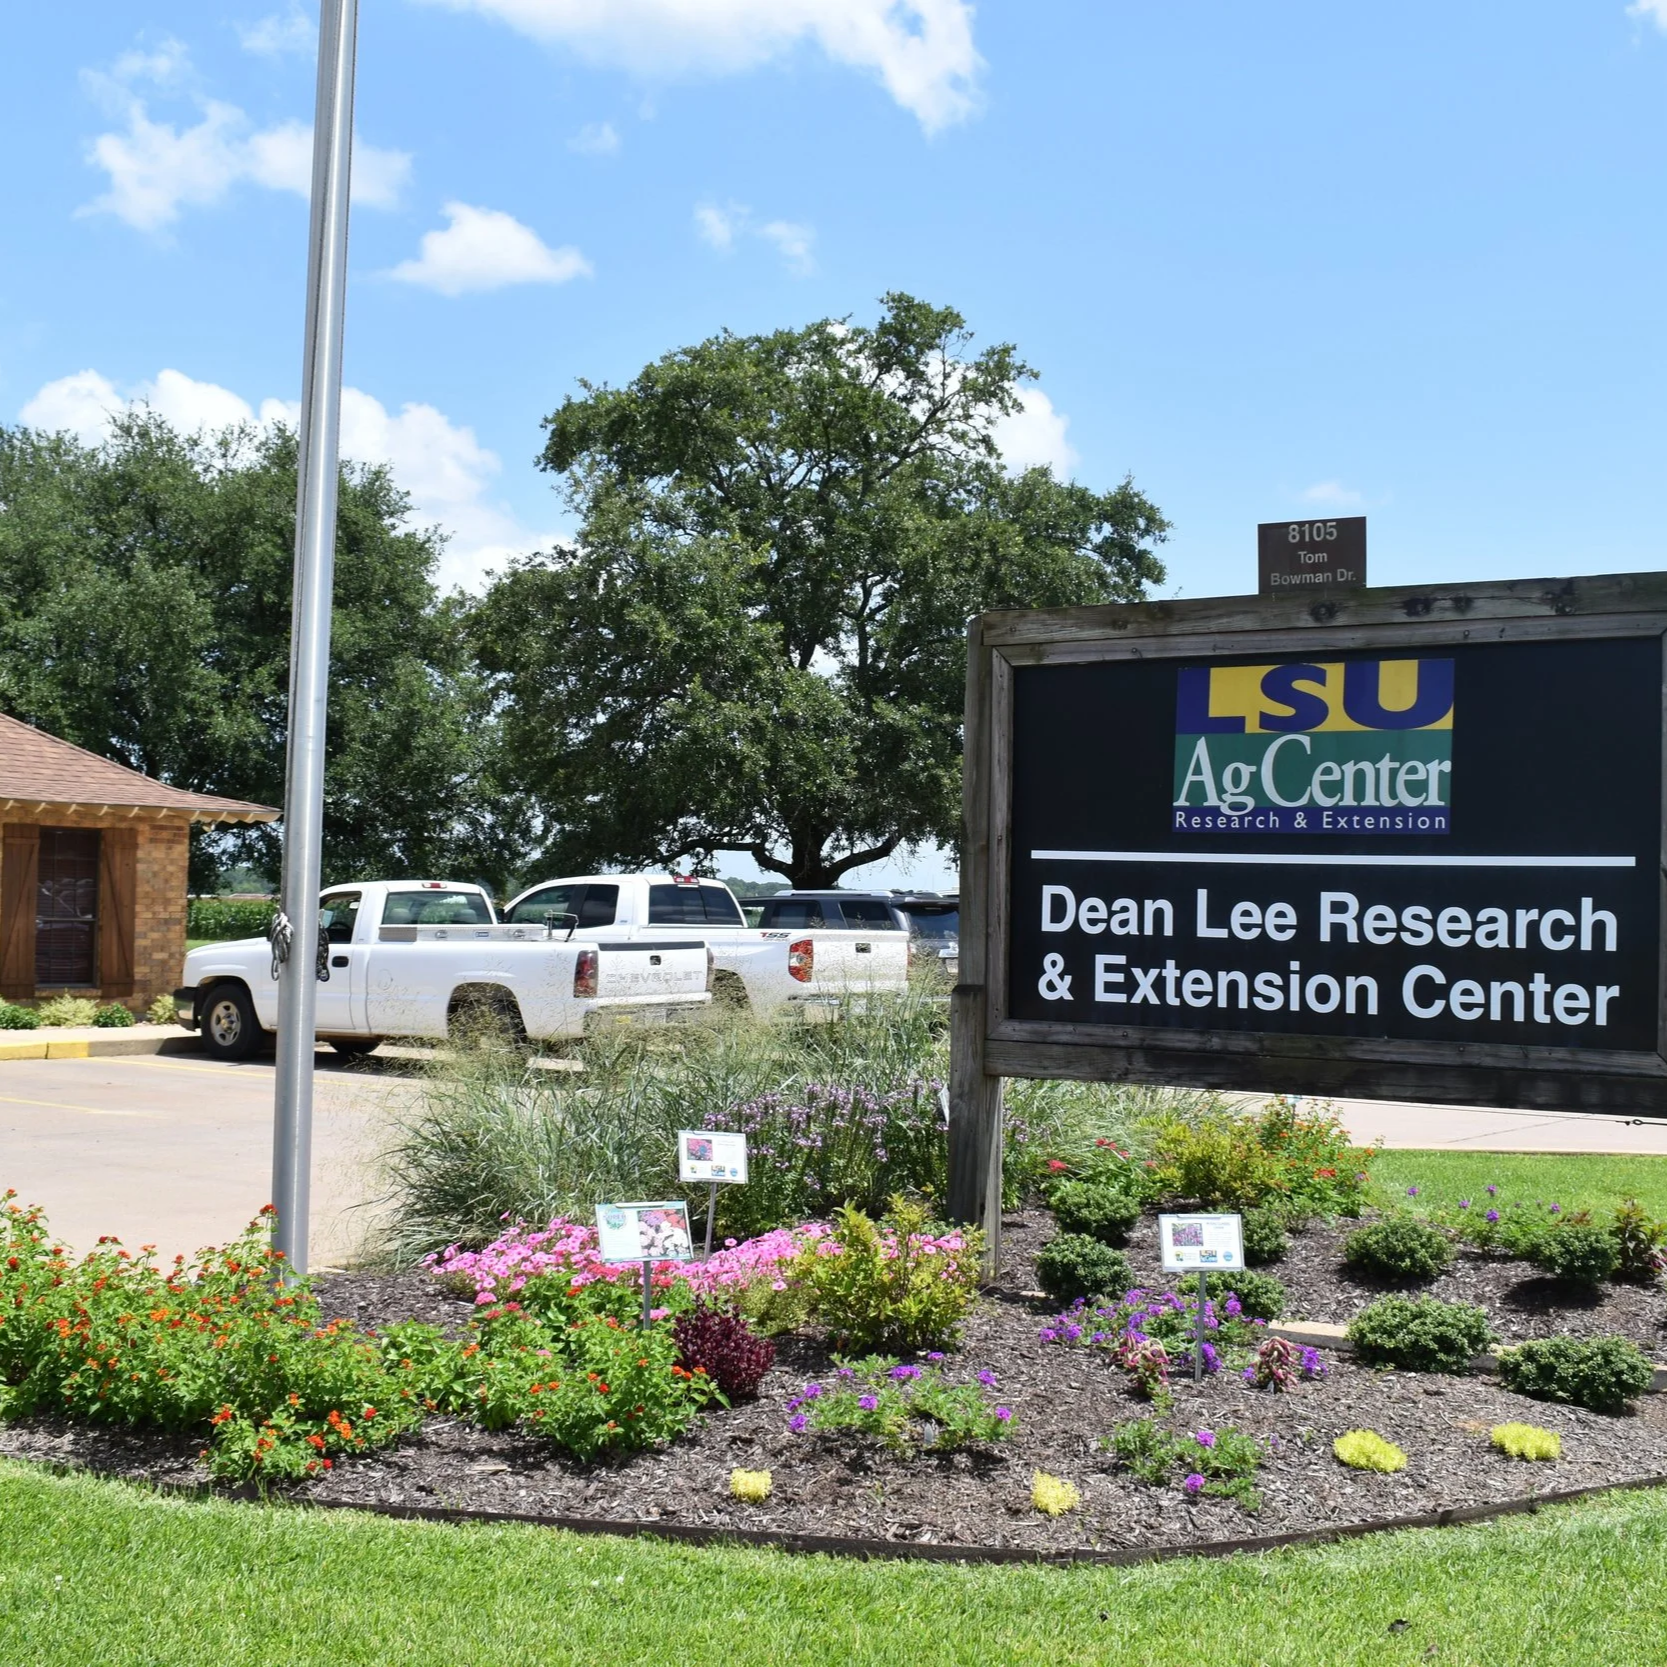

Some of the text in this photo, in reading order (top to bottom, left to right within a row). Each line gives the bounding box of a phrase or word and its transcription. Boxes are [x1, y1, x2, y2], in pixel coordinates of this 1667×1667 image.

[1288, 521, 1338, 543] 8105
[1298, 551, 1328, 564] Tom
[1270, 568, 1356, 586] Bowman Dr.
[1175, 658, 1455, 735] LSU
[1175, 811, 1446, 829] Research & Extension
[1041, 884, 1618, 952] Dean Lee Research
[605, 970, 703, 984] CHEVROLET
[1037, 952, 1620, 1026] & Extension Center
